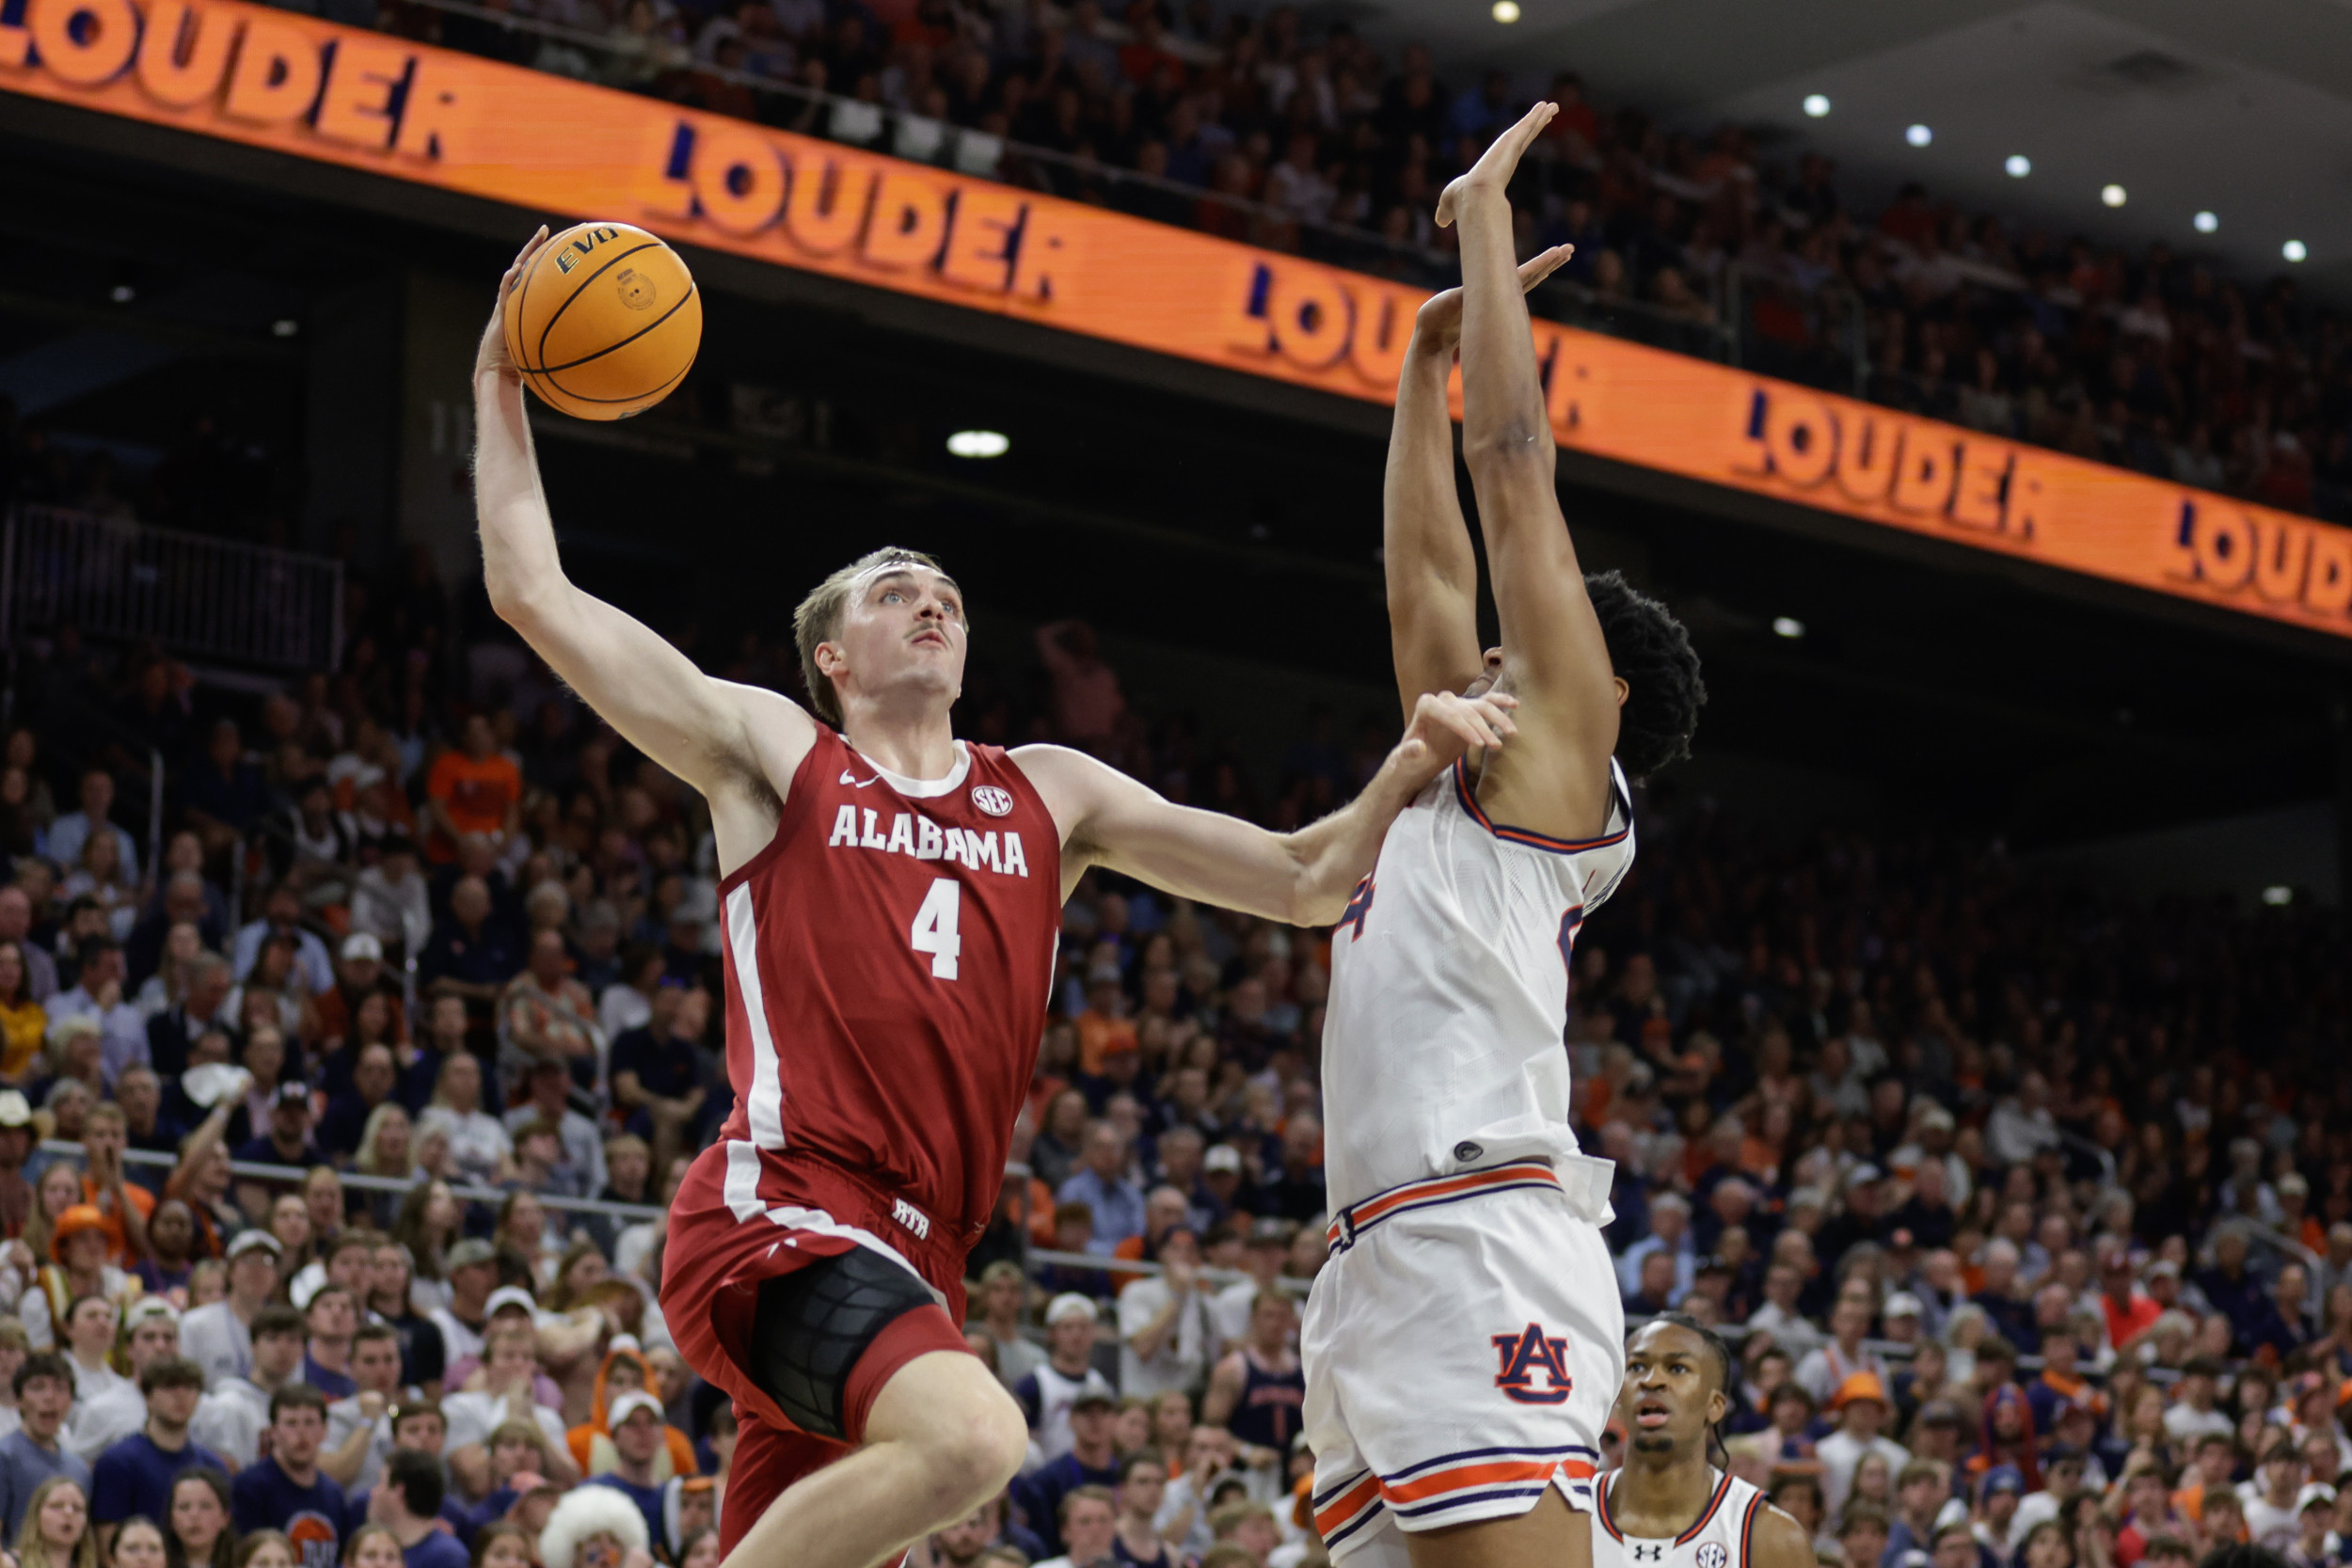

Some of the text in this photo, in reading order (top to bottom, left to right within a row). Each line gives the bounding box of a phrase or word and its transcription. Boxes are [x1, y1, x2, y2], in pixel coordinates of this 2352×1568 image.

[555, 228, 618, 274] EVO
[636, 115, 1084, 299] LOUDER
[1221, 258, 1605, 427] LOUR
[1729, 384, 2058, 543] LOUDER
[829, 804, 1028, 878] ALABAMA
[974, 786, 1012, 816] SEC
[911, 877, 961, 981] 4
